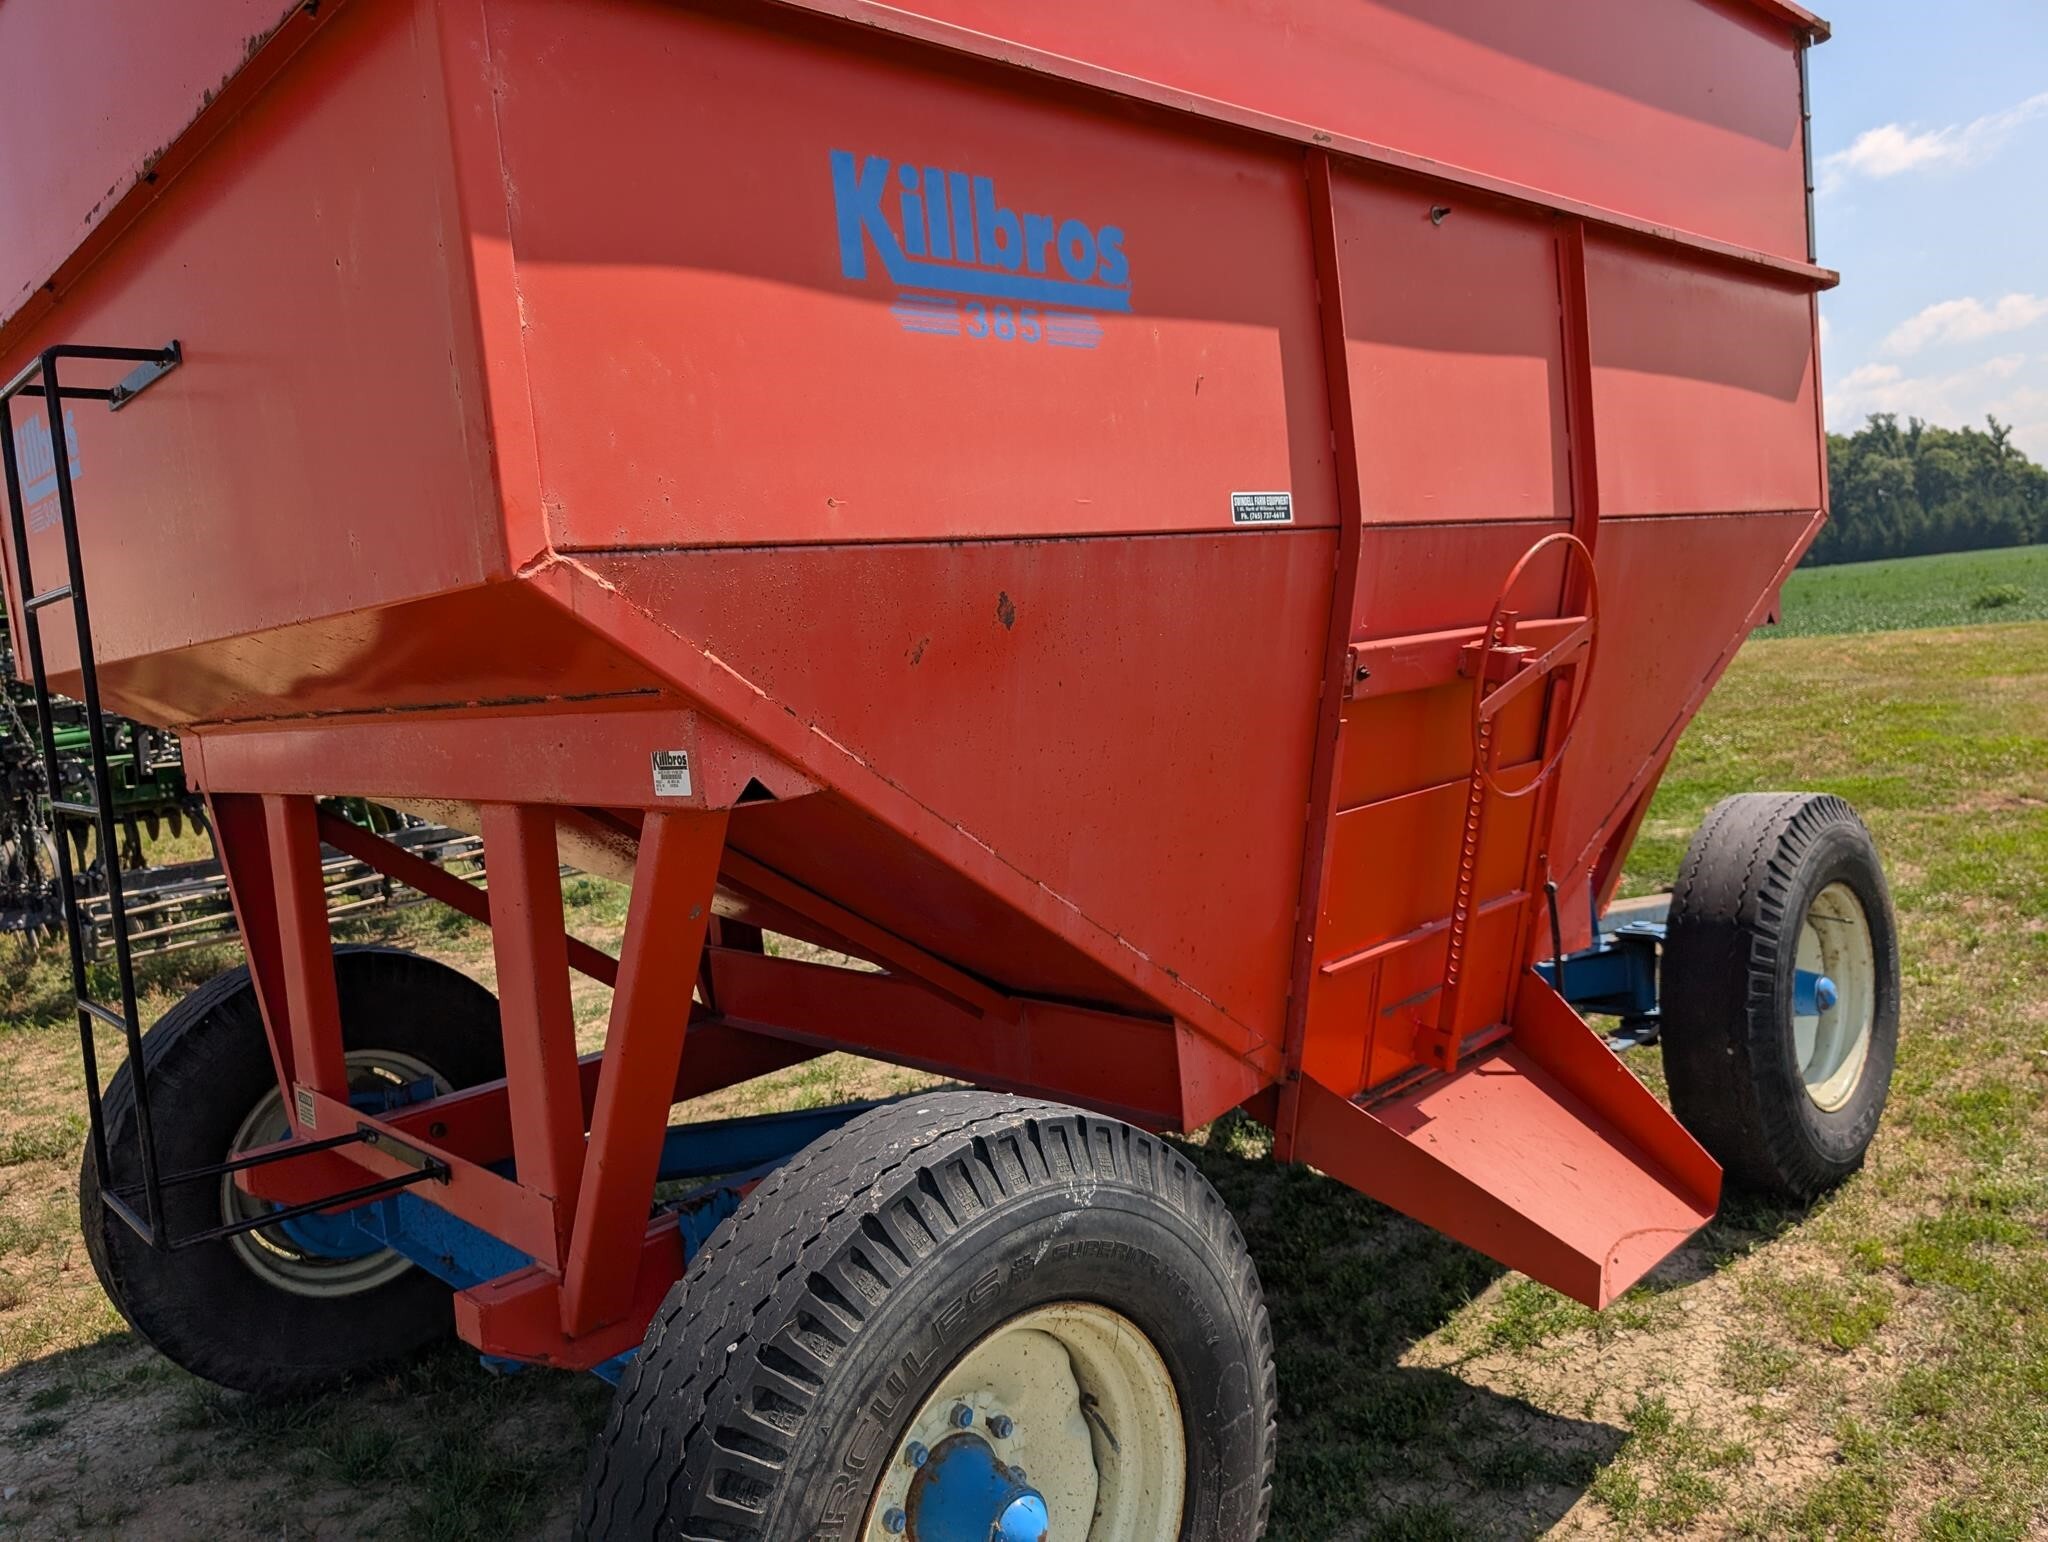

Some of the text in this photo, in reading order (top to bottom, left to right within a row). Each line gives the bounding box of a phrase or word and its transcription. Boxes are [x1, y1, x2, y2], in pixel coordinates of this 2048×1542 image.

[829, 148, 1131, 288] Killbros
[964, 302, 1042, 344] 385
[1254, 496, 1266, 506] FARM
[1266, 496, 1288, 506] EQUIPMENT
[1240, 512, 1249, 520] Ph.
[652, 751, 687, 770] Killbros
